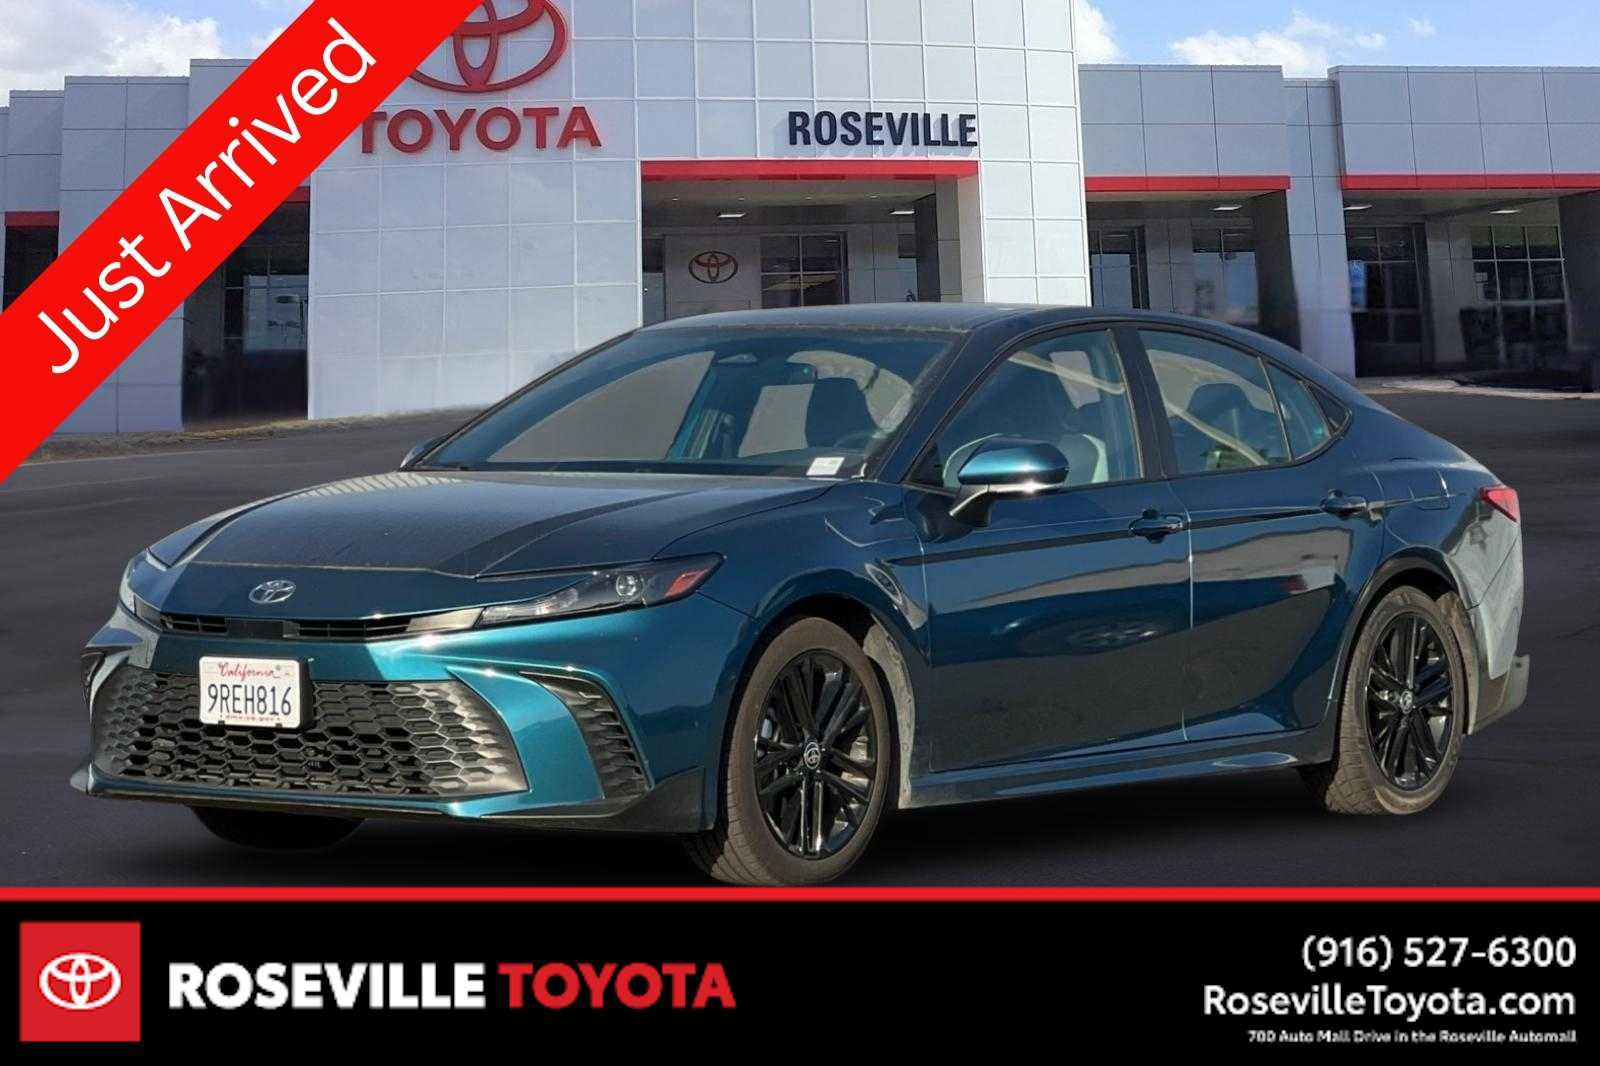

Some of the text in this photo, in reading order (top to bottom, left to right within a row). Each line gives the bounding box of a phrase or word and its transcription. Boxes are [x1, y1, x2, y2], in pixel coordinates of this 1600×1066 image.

[361, 106, 602, 154] TOYOTA
[788, 110, 978, 148] ROSEVILLE
[218, 662, 282, 681] California
[207, 683, 292, 716] 9REH816
